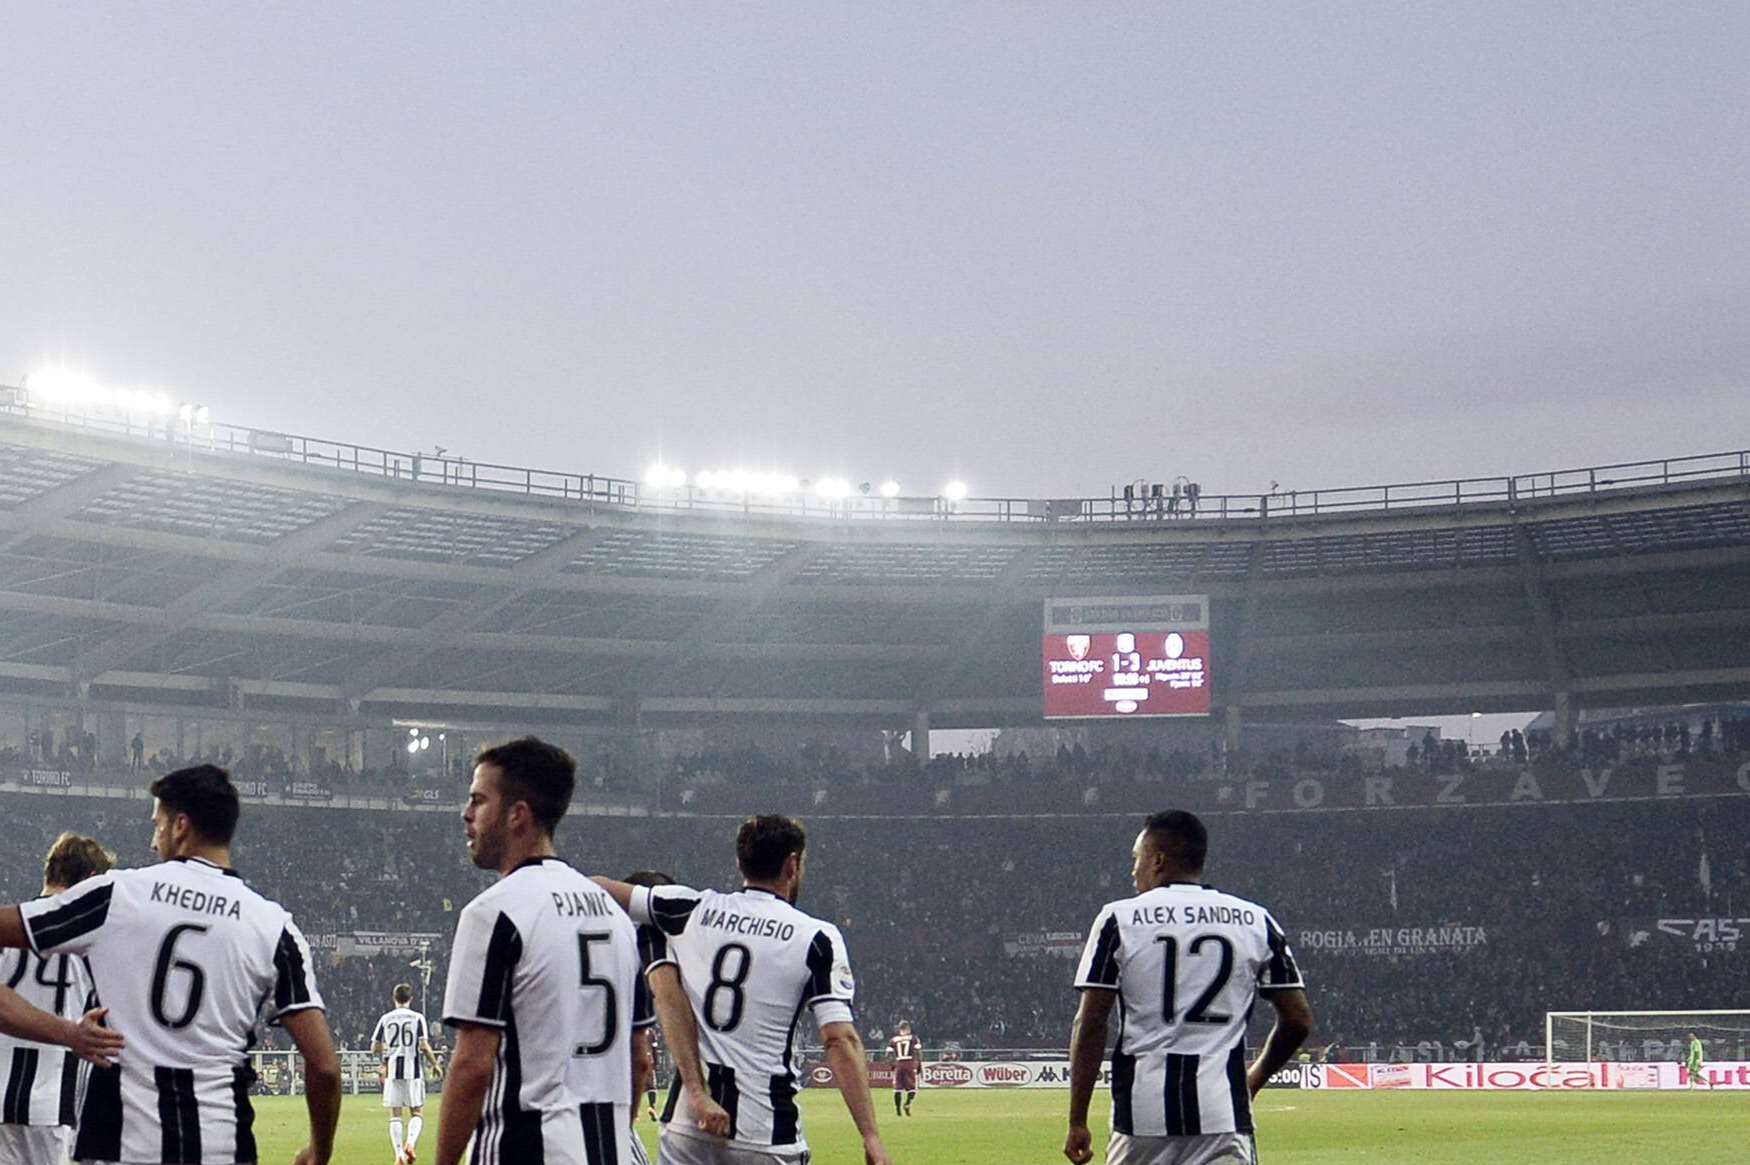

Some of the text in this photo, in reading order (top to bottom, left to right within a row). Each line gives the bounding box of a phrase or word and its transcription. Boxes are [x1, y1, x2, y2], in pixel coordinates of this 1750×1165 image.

[257, 783, 267, 795] FC
[150, 881, 242, 920] KHEDIRA
[700, 909, 795, 941] MARCHISIO
[1132, 906, 1254, 926] ALEX SANDRO
[1397, 926, 1488, 946] GRANATA
[150, 922, 211, 1030] 6
[703, 942, 752, 1033] 8
[1152, 933, 1235, 1025] 12
[572, 929, 618, 1058] 5
[388, 1021, 413, 1048] 26
[896, 1041, 911, 1058] 17
[922, 1068, 972, 1081] Beretta
[983, 1066, 1027, 1082] Wüber
